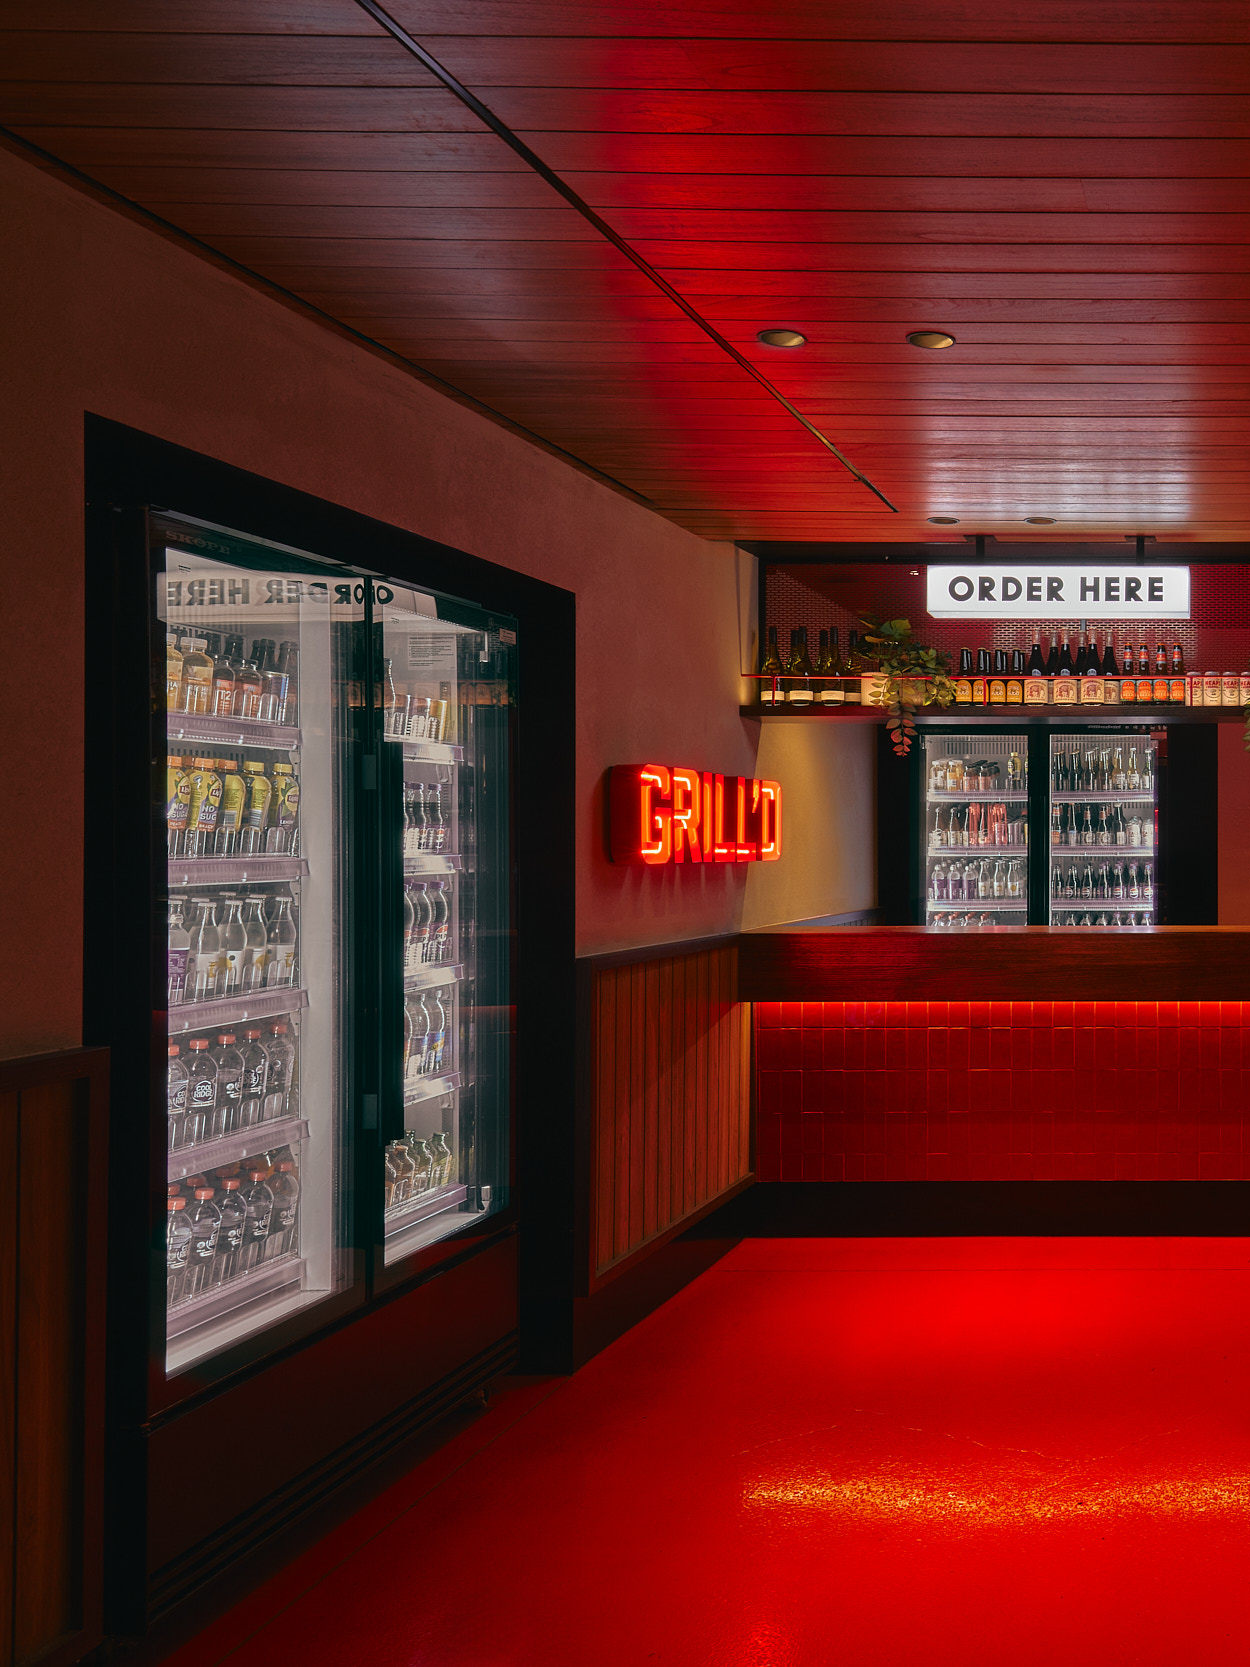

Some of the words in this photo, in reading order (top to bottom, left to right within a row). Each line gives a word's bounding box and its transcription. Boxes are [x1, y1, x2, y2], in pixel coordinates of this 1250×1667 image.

[948, 575, 1065, 602] ORDER
[1080, 576, 1164, 602] HERE
[200, 813, 217, 821] SUG
[196, 1084, 212, 1092] COOL
